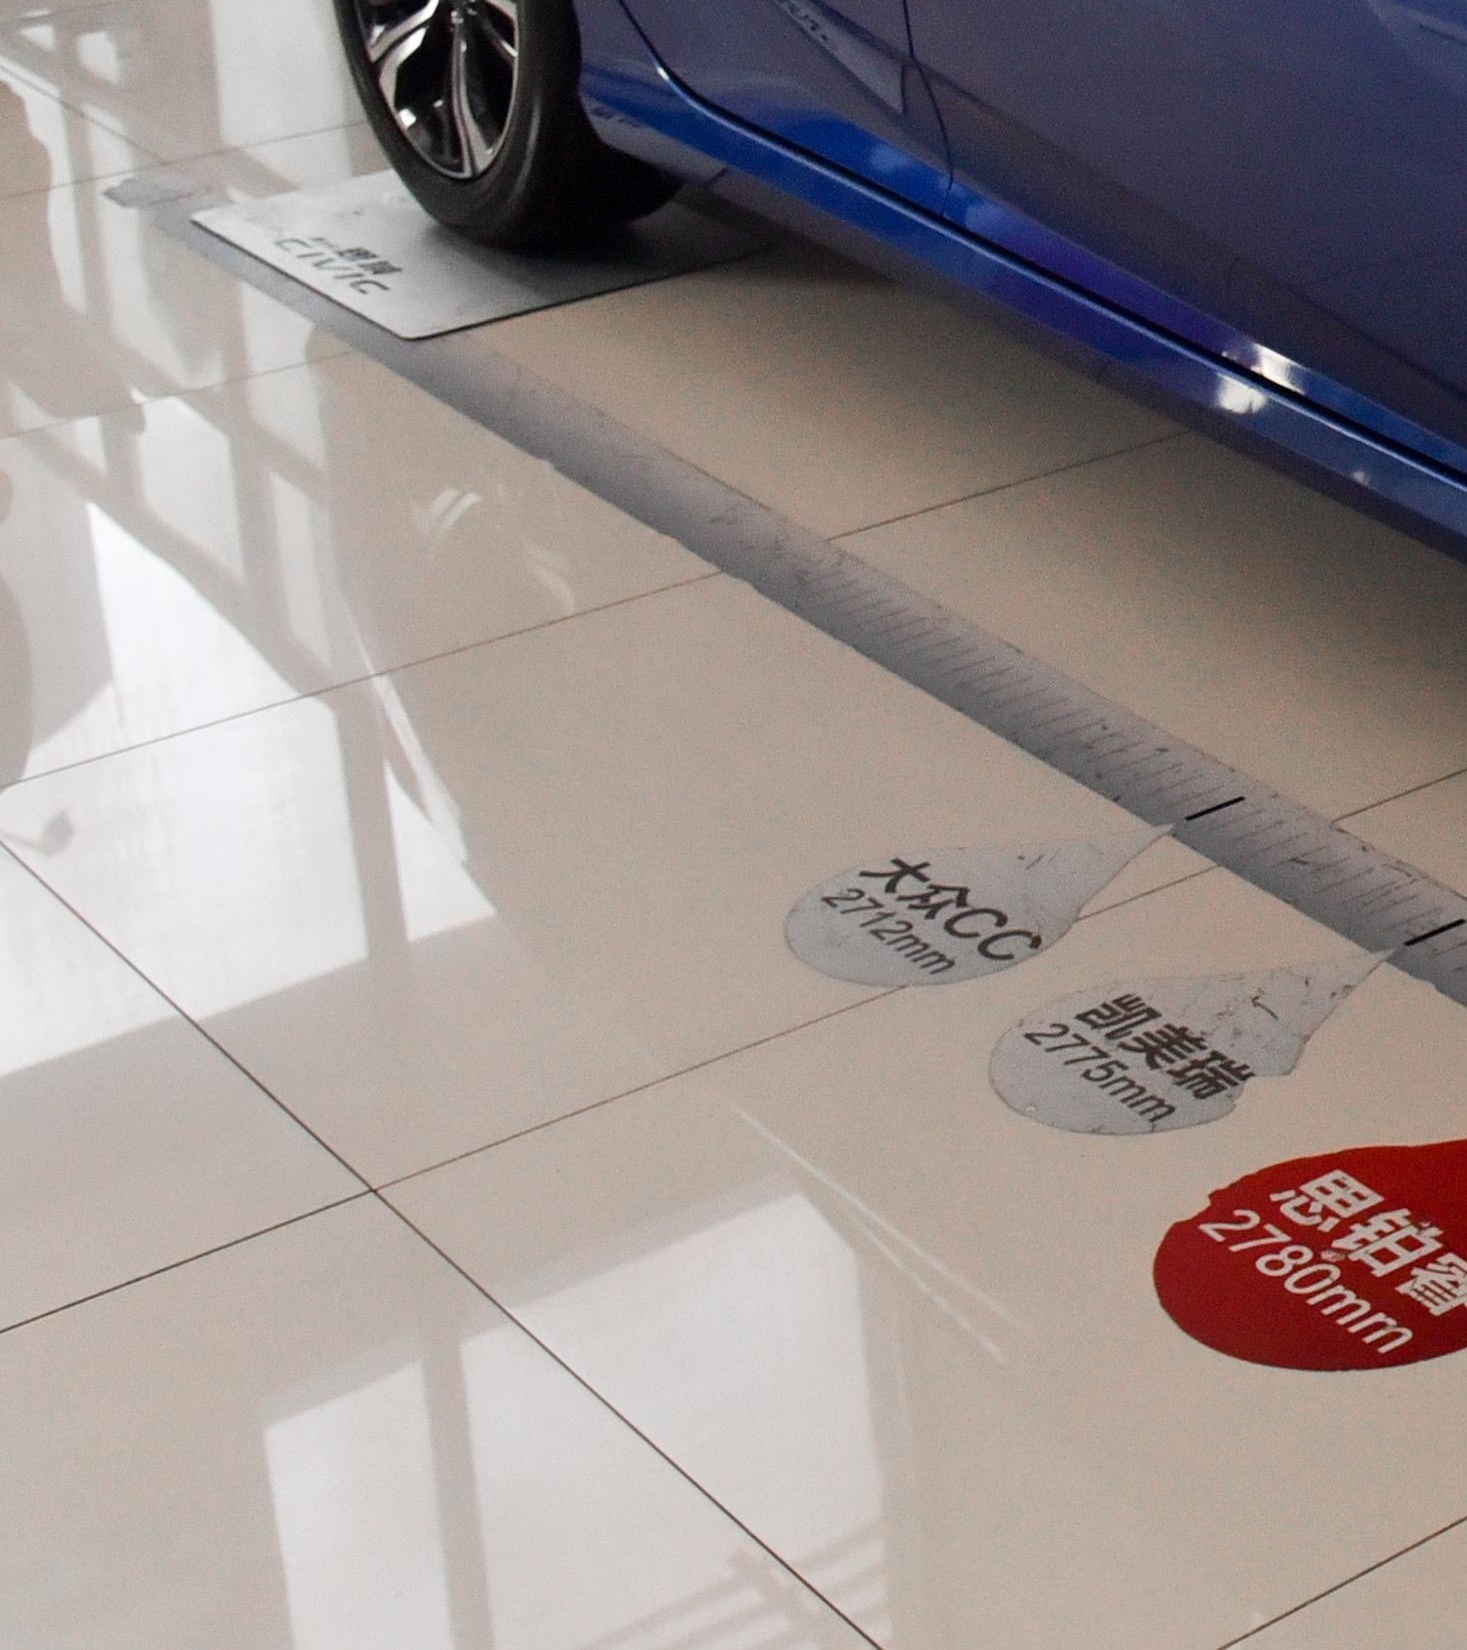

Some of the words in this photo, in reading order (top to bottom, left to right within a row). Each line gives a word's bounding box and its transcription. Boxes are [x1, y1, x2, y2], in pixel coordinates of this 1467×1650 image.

[273, 238, 391, 295] CIVIC
[820, 888, 955, 975] 2712mm
[858, 857, 1043, 961] 大众CC
[1023, 1023, 1176, 1123] 2775mm
[1074, 993, 1256, 1100] 凯美瑞
[1199, 1208, 1414, 1354] 2780mm
